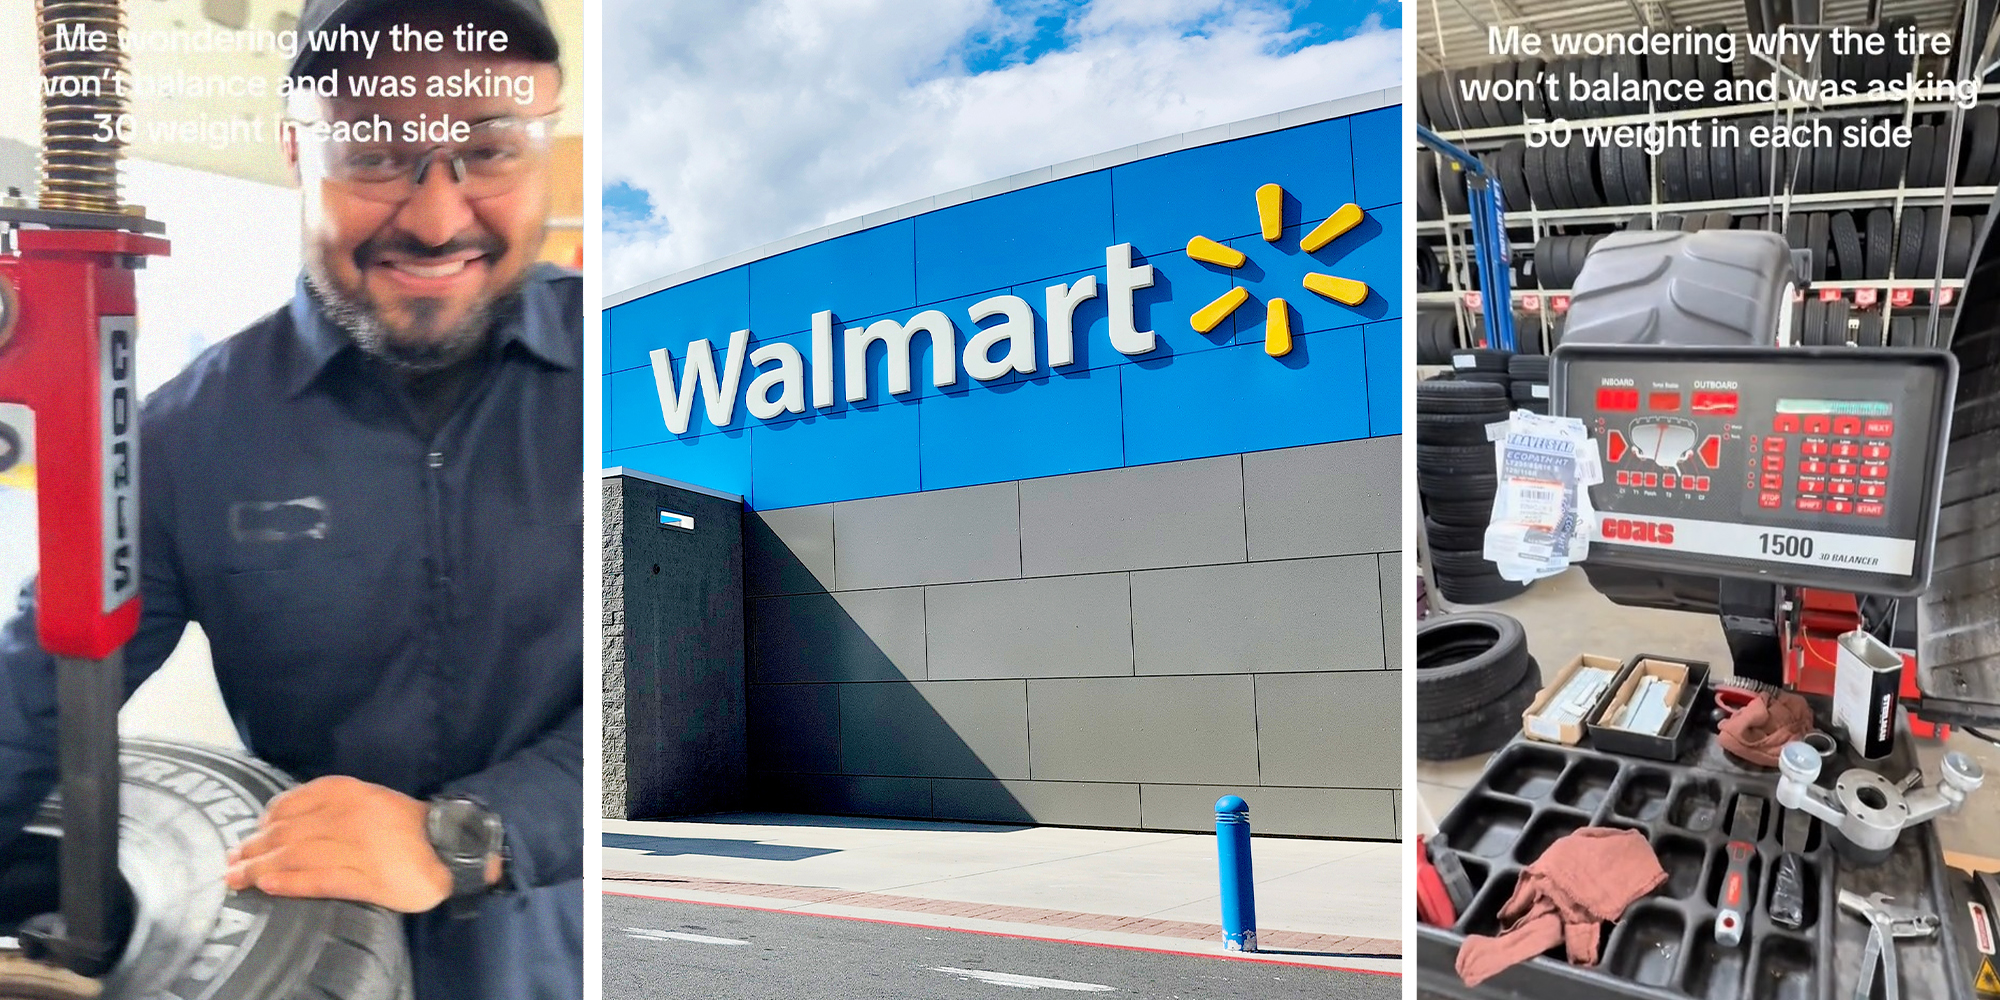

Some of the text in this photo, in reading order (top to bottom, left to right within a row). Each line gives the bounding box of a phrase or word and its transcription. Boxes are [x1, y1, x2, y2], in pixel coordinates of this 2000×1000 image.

[649, 242, 1156, 435] Walmart
[1601, 378, 1738, 389] INBOARD OUTBOARD
[1507, 433, 1575, 453] TRAVELSTAR
[1506, 450, 1553, 463] ECOPATH
[1858, 505, 1881, 513] START
[1758, 533, 1814, 558] 1500
[1832, 553, 1879, 567] BALANCER
